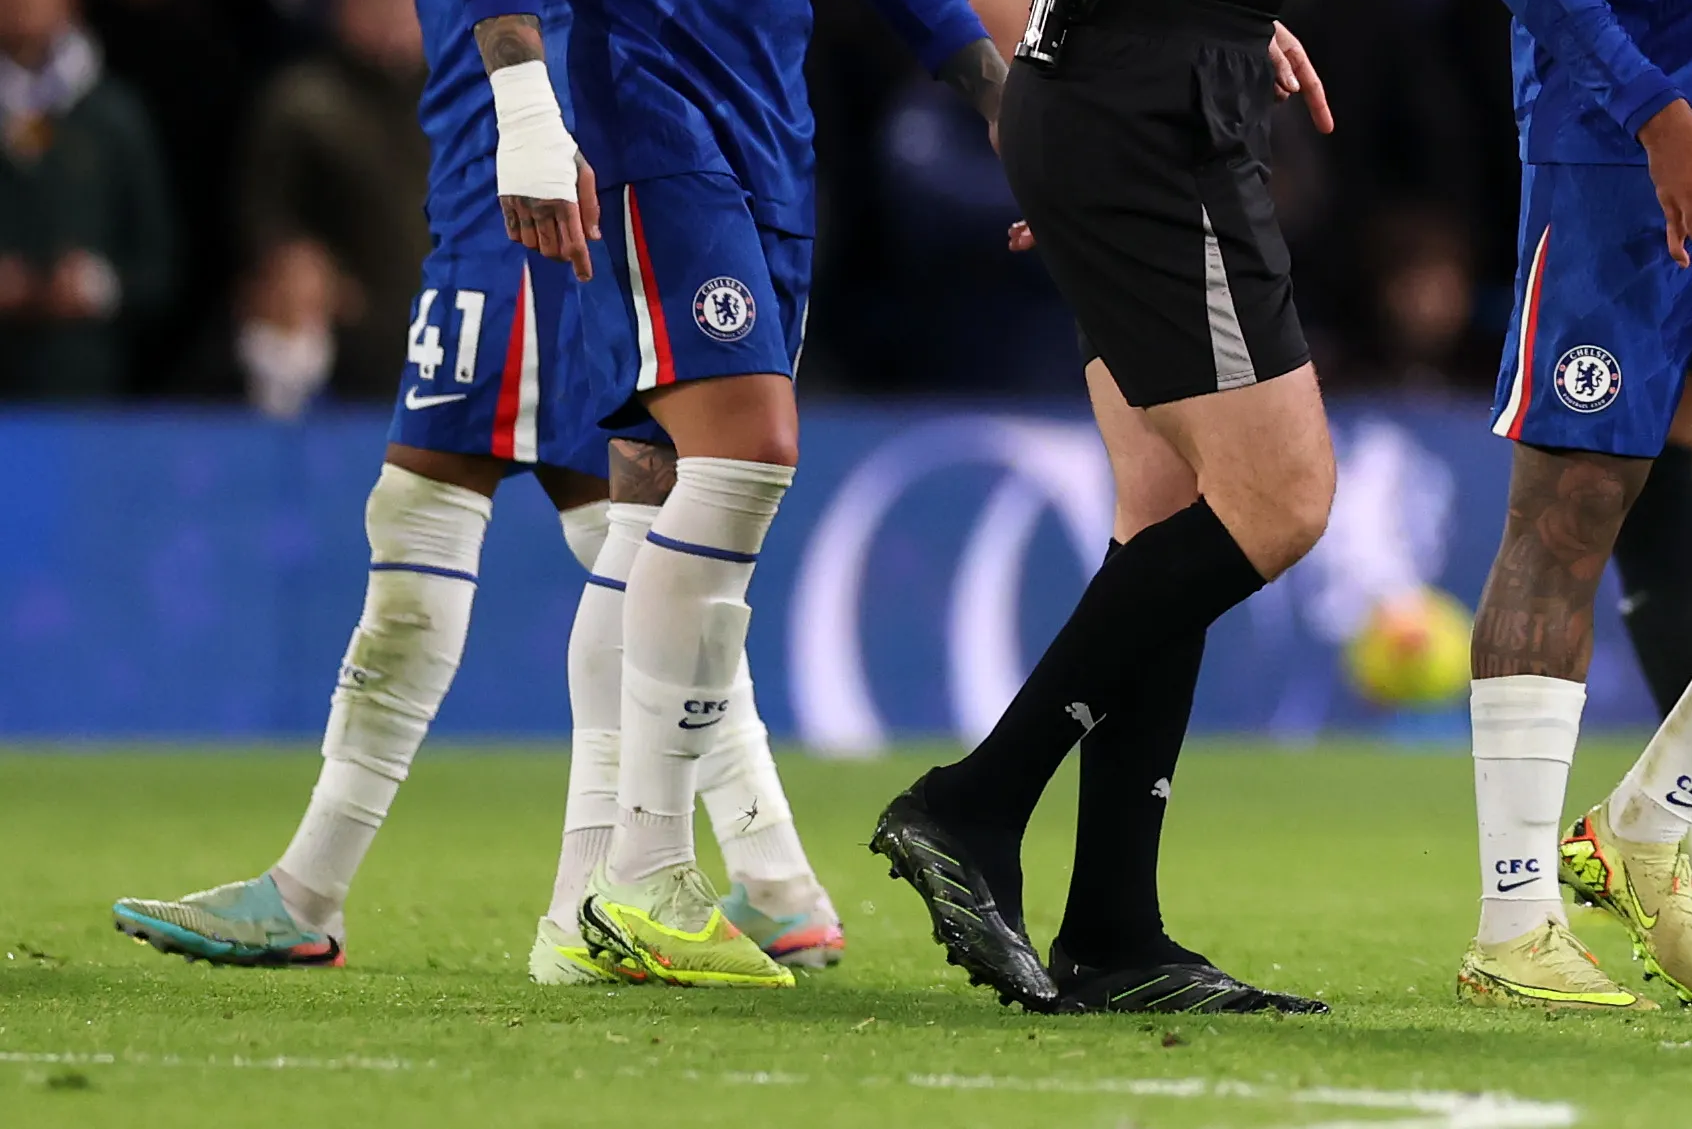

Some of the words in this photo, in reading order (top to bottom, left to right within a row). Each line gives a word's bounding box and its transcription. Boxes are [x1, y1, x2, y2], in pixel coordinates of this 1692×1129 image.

[407, 288, 486, 384] 41
[1569, 348, 1612, 366] CHELSEA
[683, 699, 729, 714] CFC
[1495, 858, 1540, 875] CFC
